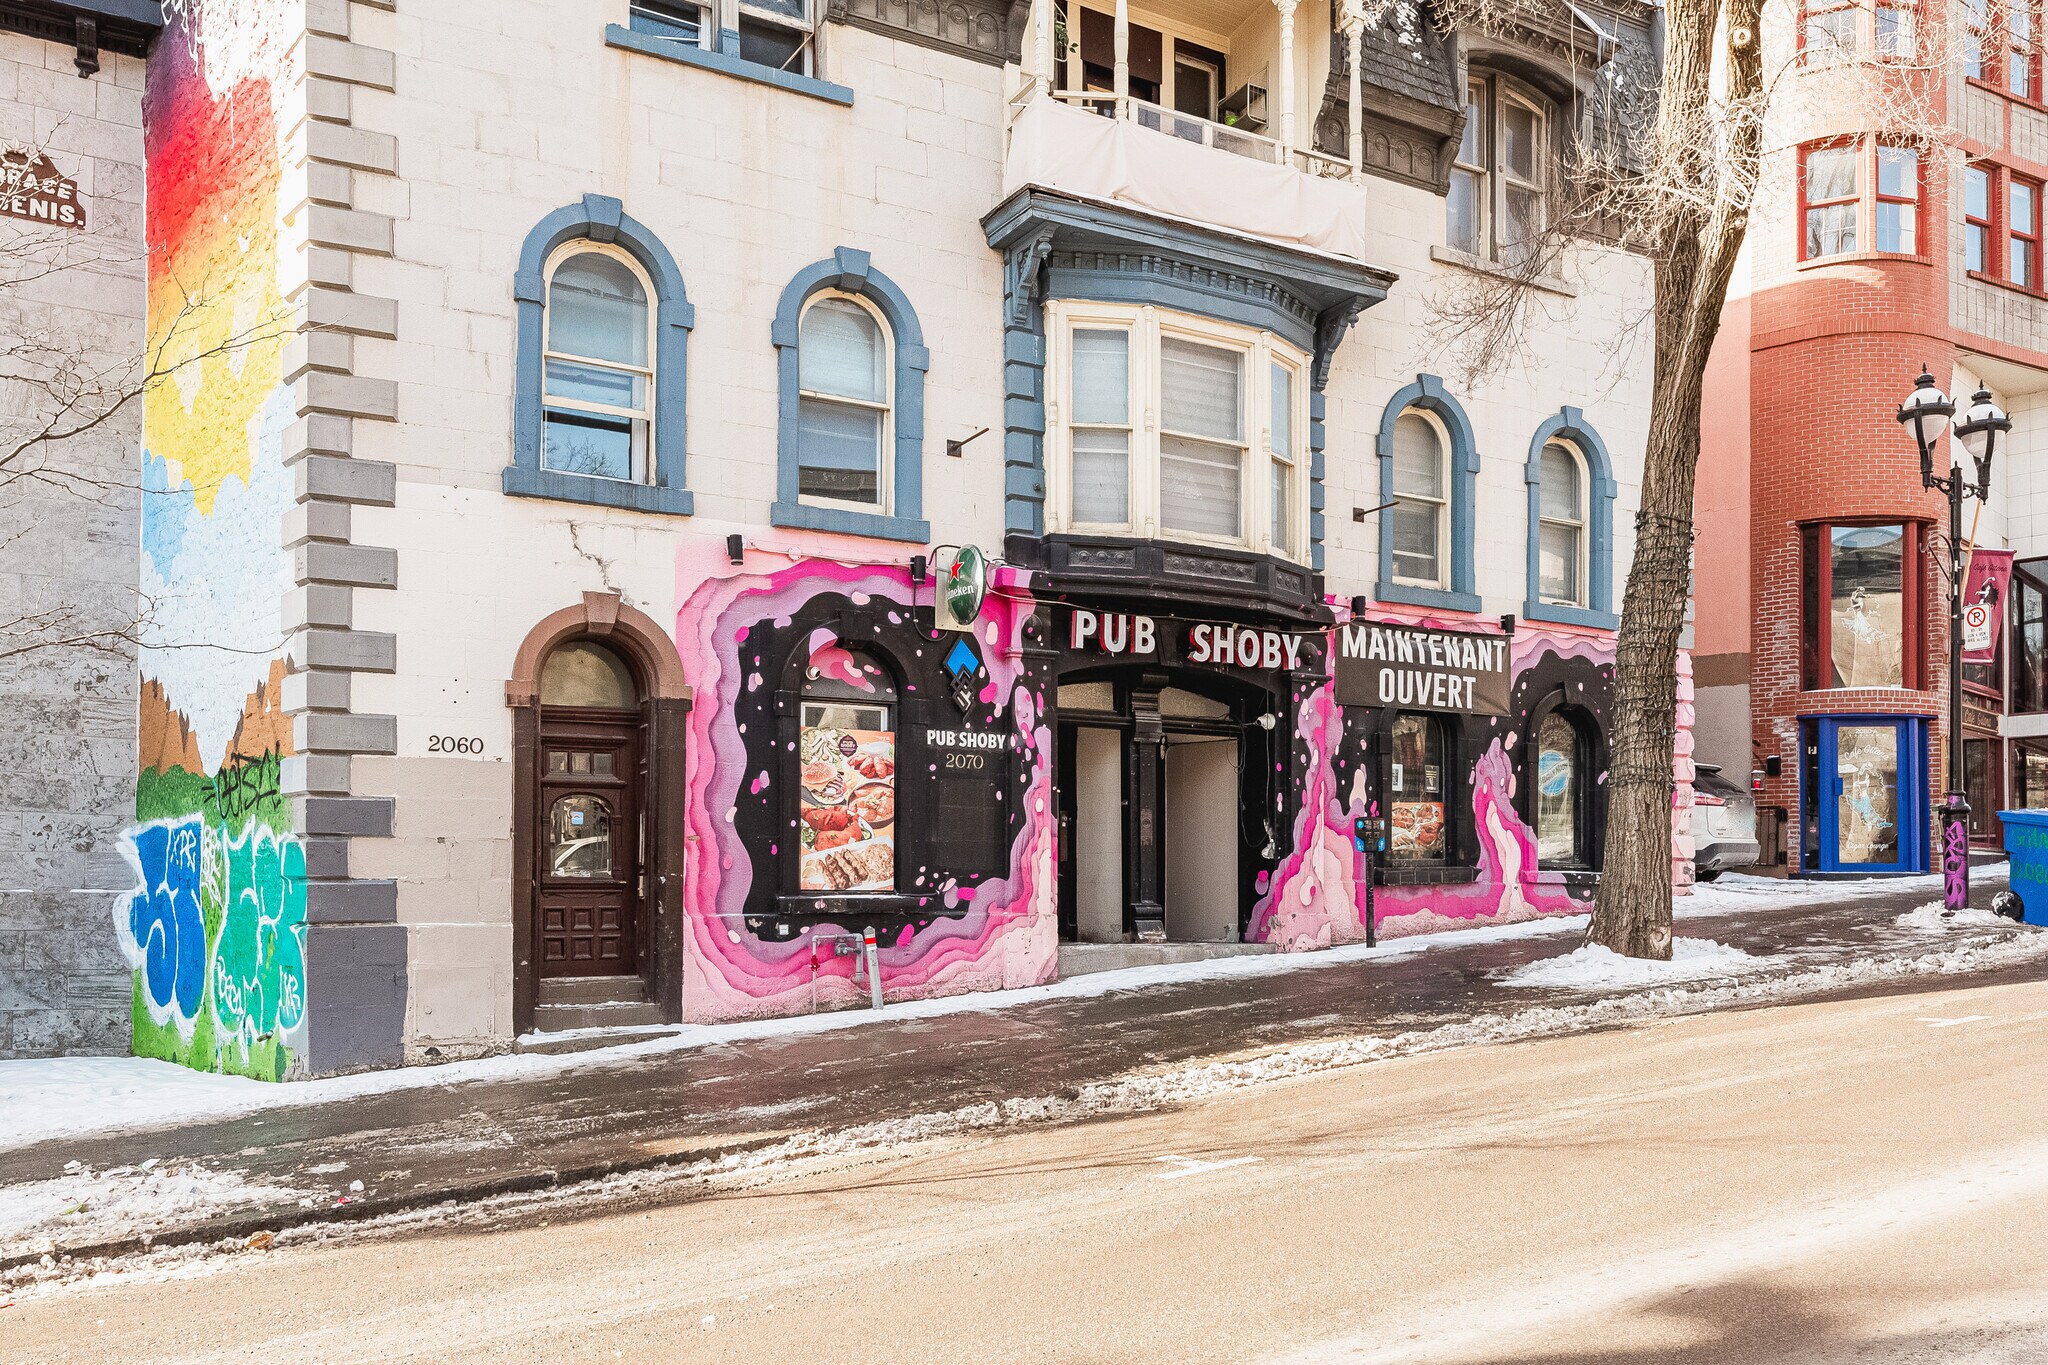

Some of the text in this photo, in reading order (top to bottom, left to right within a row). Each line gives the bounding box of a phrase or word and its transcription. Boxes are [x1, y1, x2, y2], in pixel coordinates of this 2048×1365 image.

[1071, 610, 1302, 671] PUB SHOBY
[1342, 624, 1506, 673] MAINTENANT
[1379, 668, 1476, 709] OUVERT
[428, 735, 484, 754] 2060
[927, 729, 1006, 749] PUB SHOBY
[946, 753, 984, 769] 2070
[1867, 842, 1889, 852] Lounge
